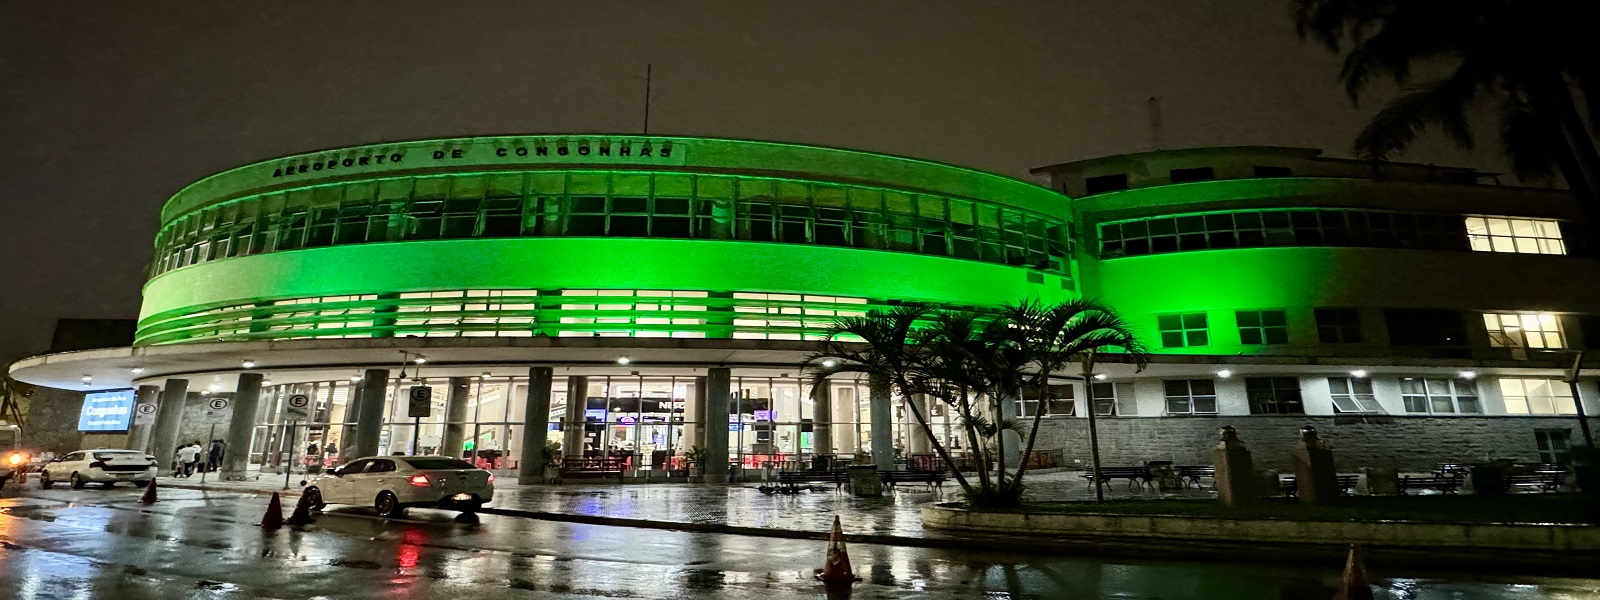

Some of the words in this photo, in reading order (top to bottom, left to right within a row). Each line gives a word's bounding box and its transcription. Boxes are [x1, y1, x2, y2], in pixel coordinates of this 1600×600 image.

[272, 153, 403, 177] AEROPORTO
[432, 149, 463, 160] DE
[495, 146, 673, 158] CONGONHAS
[417, 389, 425, 399] E
[214, 400, 222, 408] E
[295, 397, 302, 405] E
